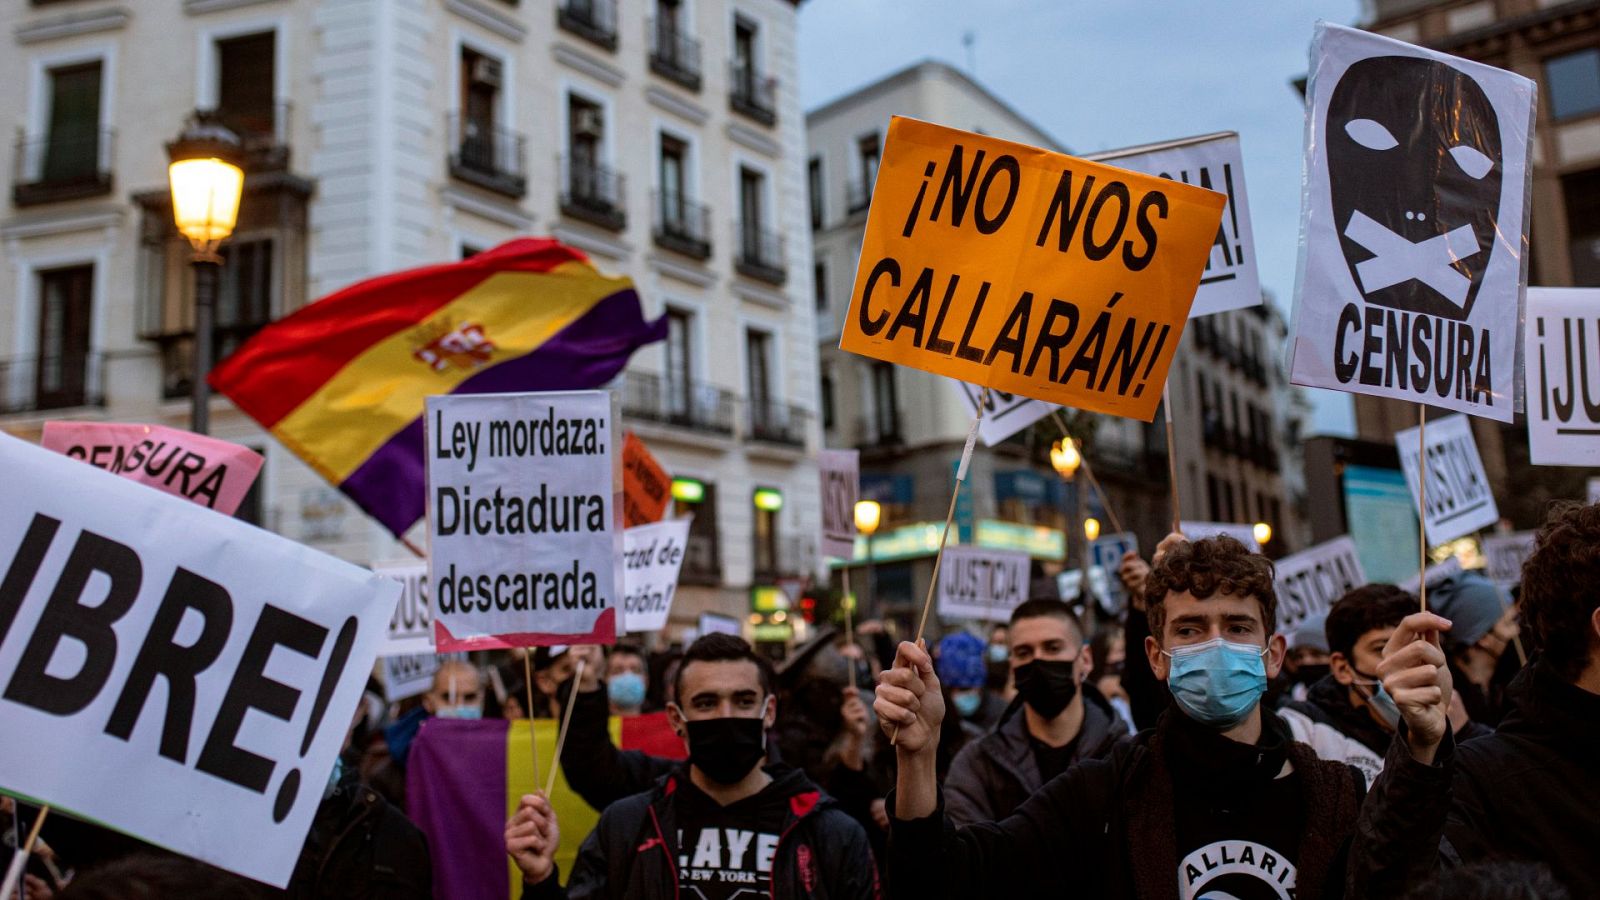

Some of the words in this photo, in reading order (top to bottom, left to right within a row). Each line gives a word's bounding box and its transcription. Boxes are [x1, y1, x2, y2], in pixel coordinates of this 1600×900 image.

[902, 144, 1021, 238] ¡NO
[1036, 169, 1169, 271] NOS
[859, 257, 1171, 399] CALLARÁN!
[1334, 302, 1493, 406] CENSURA
[436, 409, 481, 472] Ley
[489, 407, 606, 457] mordaza:
[436, 483, 606, 536] Dictadura
[438, 560, 606, 614] descarada.
[719, 871, 757, 883] YORK
